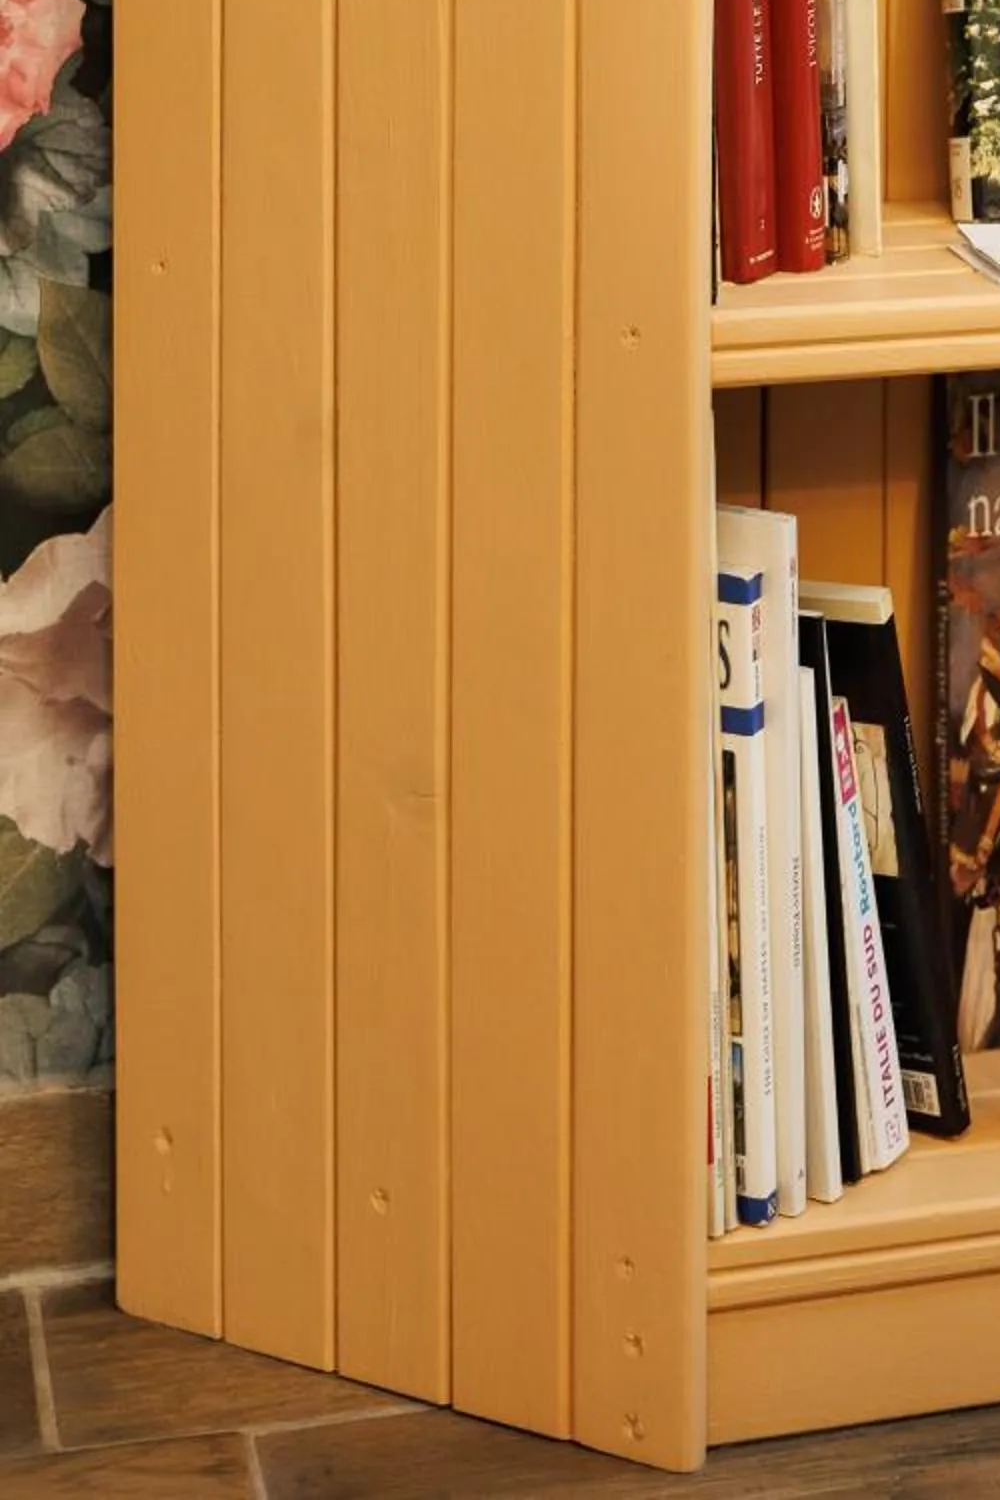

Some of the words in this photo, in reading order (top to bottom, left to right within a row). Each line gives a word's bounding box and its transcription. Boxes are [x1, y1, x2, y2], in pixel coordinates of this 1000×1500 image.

[753, 6, 763, 28] LE
[754, 31, 764, 85] TUTTE
[968, 393, 999, 458] Il
[847, 800, 871, 916] Routard
[863, 924, 879, 979] SUD
[869, 983, 884, 1023] DU
[875, 1024, 895, 1109] ITALIE
